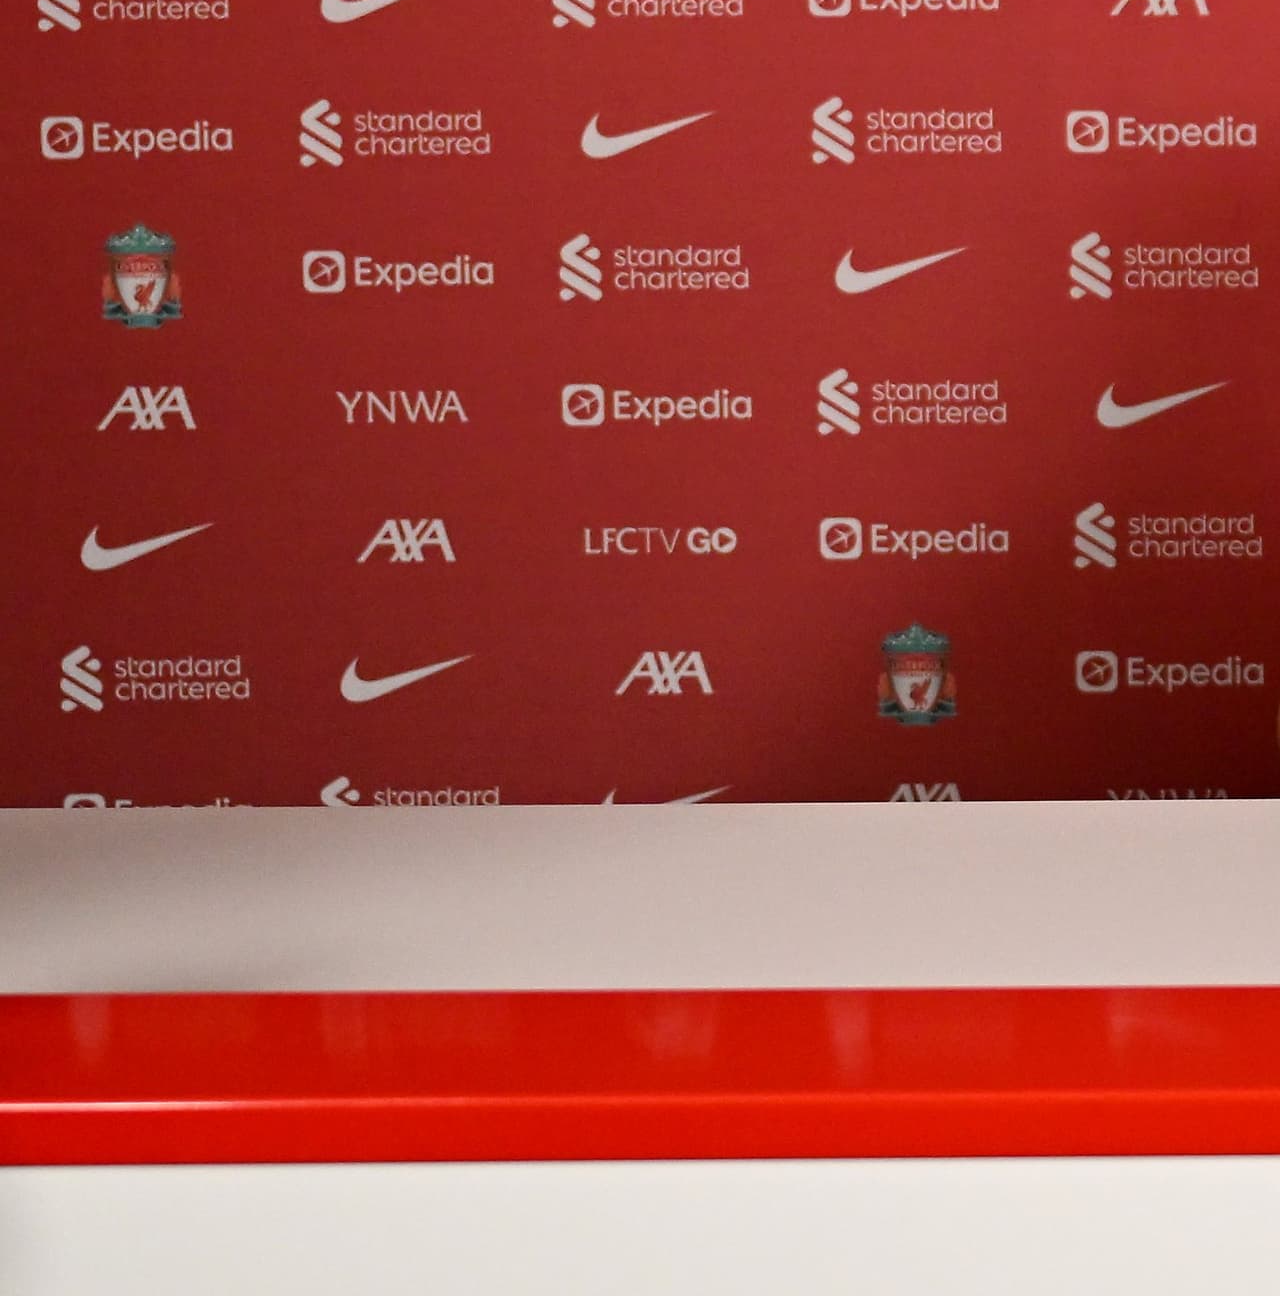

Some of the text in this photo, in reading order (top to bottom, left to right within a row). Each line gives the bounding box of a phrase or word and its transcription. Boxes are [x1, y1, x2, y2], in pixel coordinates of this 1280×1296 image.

[354, 110, 482, 132] standard
[1118, 116, 1256, 153] Expedia
[92, 120, 233, 159] Expedia
[355, 133, 490, 155] chartered
[614, 245, 740, 268] standard
[354, 255, 494, 293] Expedia
[614, 268, 749, 290] chartered
[872, 380, 998, 403] standard
[97, 386, 196, 431] AXA
[336, 390, 468, 423] YNWA
[613, 389, 752, 426] Expedia
[872, 403, 1007, 424] chartered
[1129, 515, 1254, 534] standard
[357, 519, 456, 563] AXA
[870, 523, 1009, 560] Expedia
[1129, 538, 1262, 557] chartered
[115, 656, 241, 678] standard
[615, 651, 713, 695] AXA
[1127, 657, 1263, 691] Expedia
[115, 679, 250, 700] chartered
